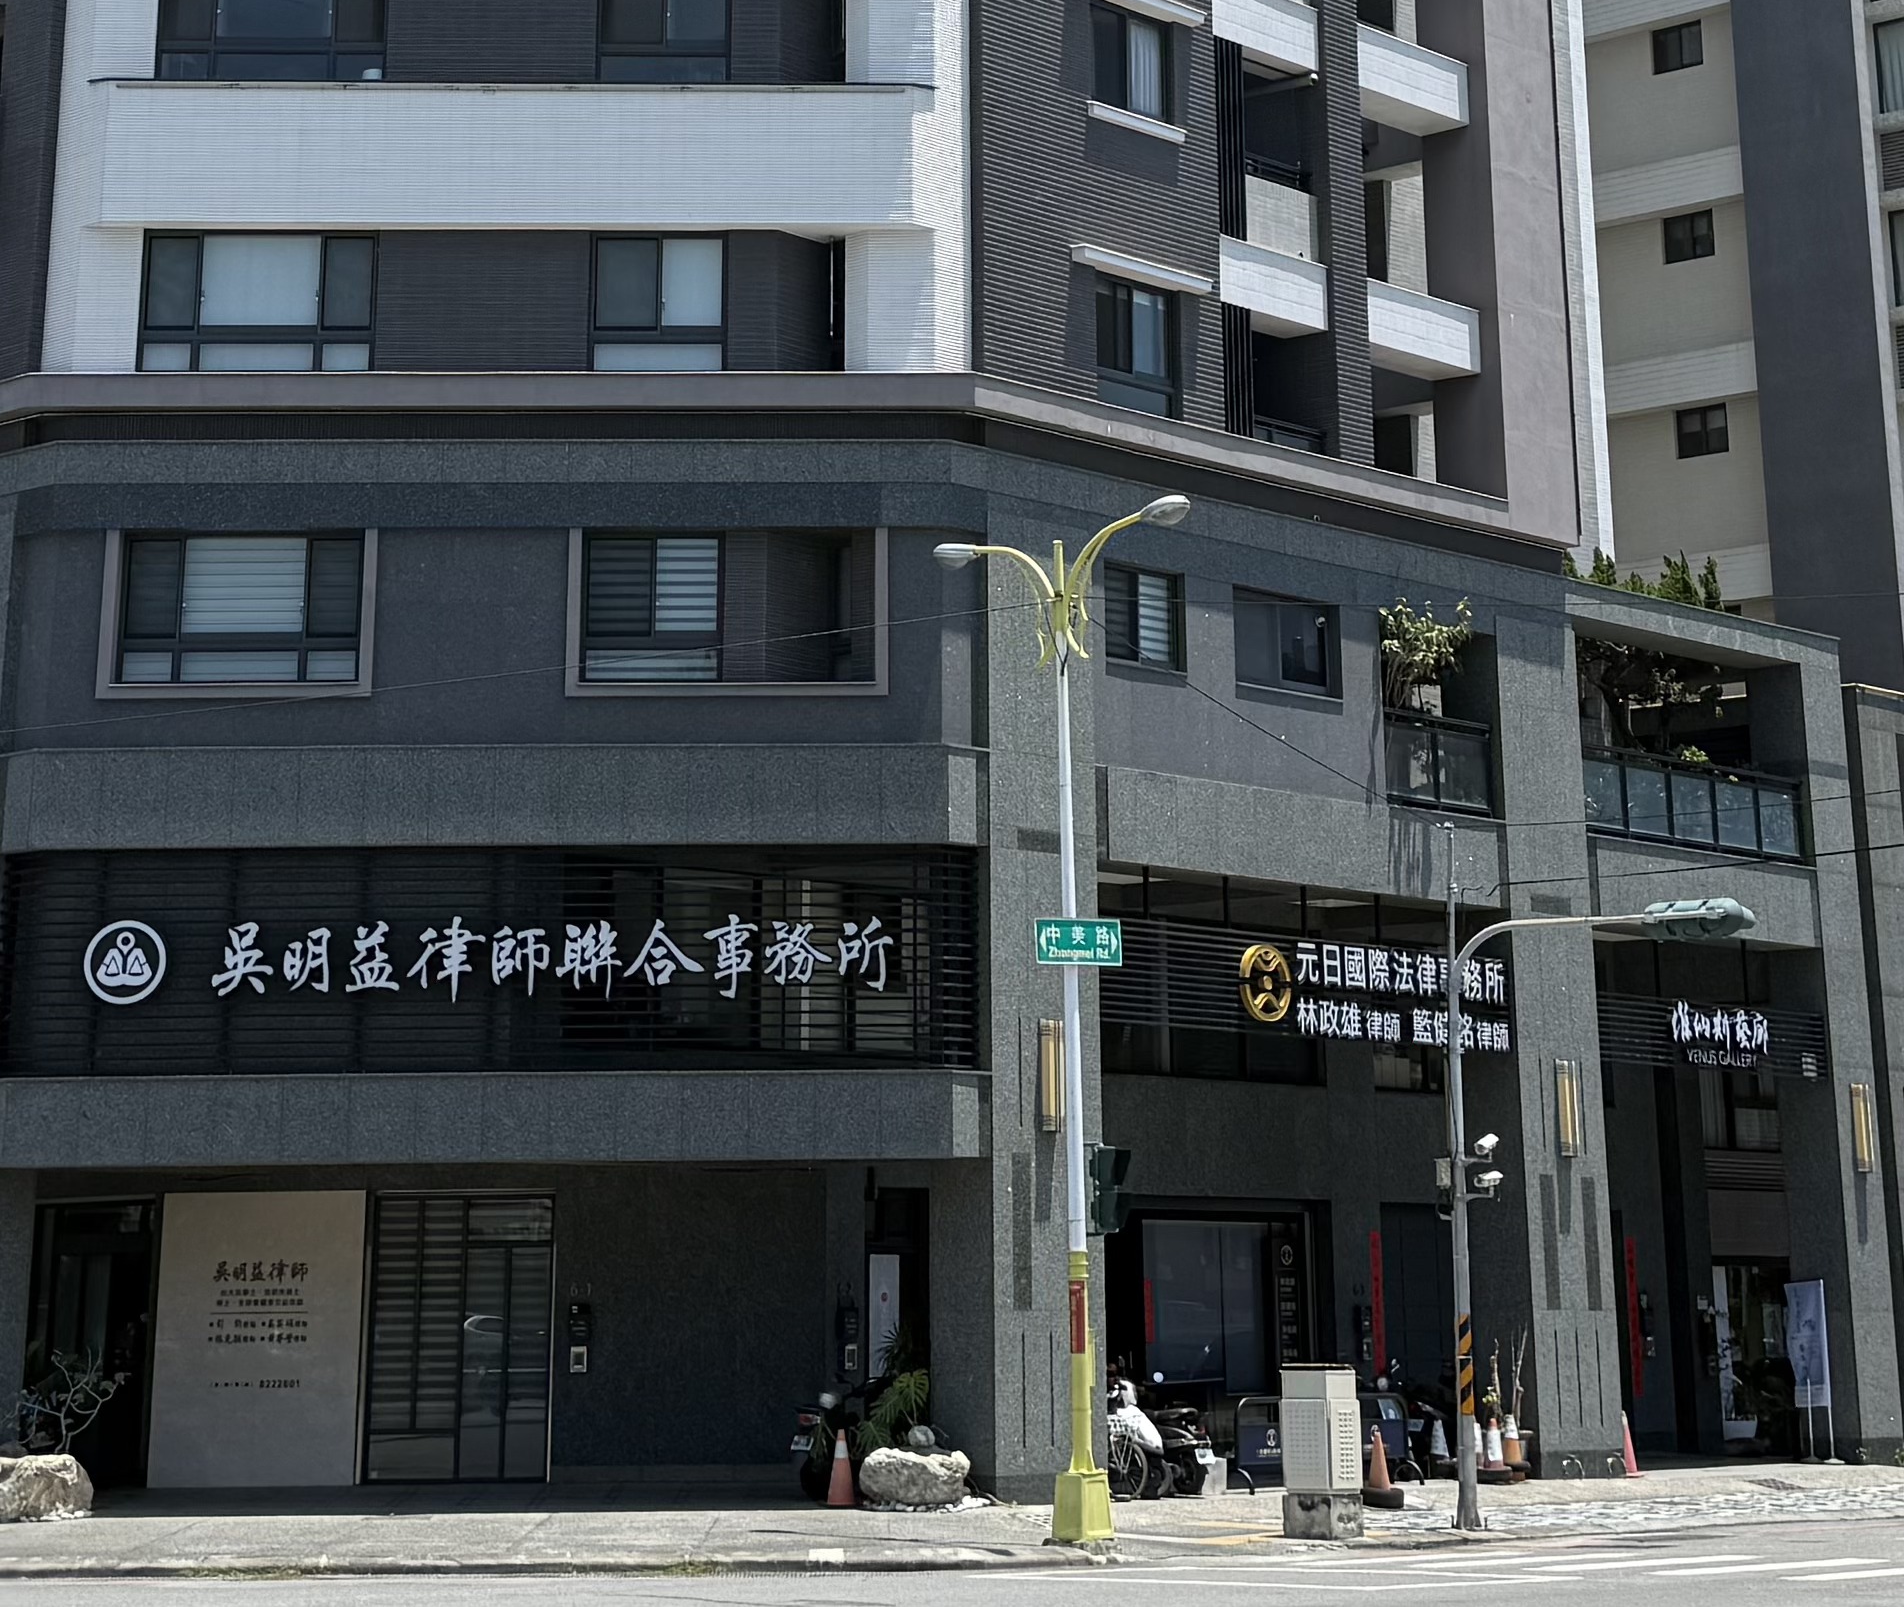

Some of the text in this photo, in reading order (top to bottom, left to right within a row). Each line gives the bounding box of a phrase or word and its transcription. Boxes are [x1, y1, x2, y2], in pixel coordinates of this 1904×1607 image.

[1046, 923, 1110, 946] 中美路
[211, 913, 894, 1004] 吳明益律師聯合事務所
[1297, 996, 1402, 1043] 林政雄律師
[213, 1259, 309, 1285] 吳明益律師
